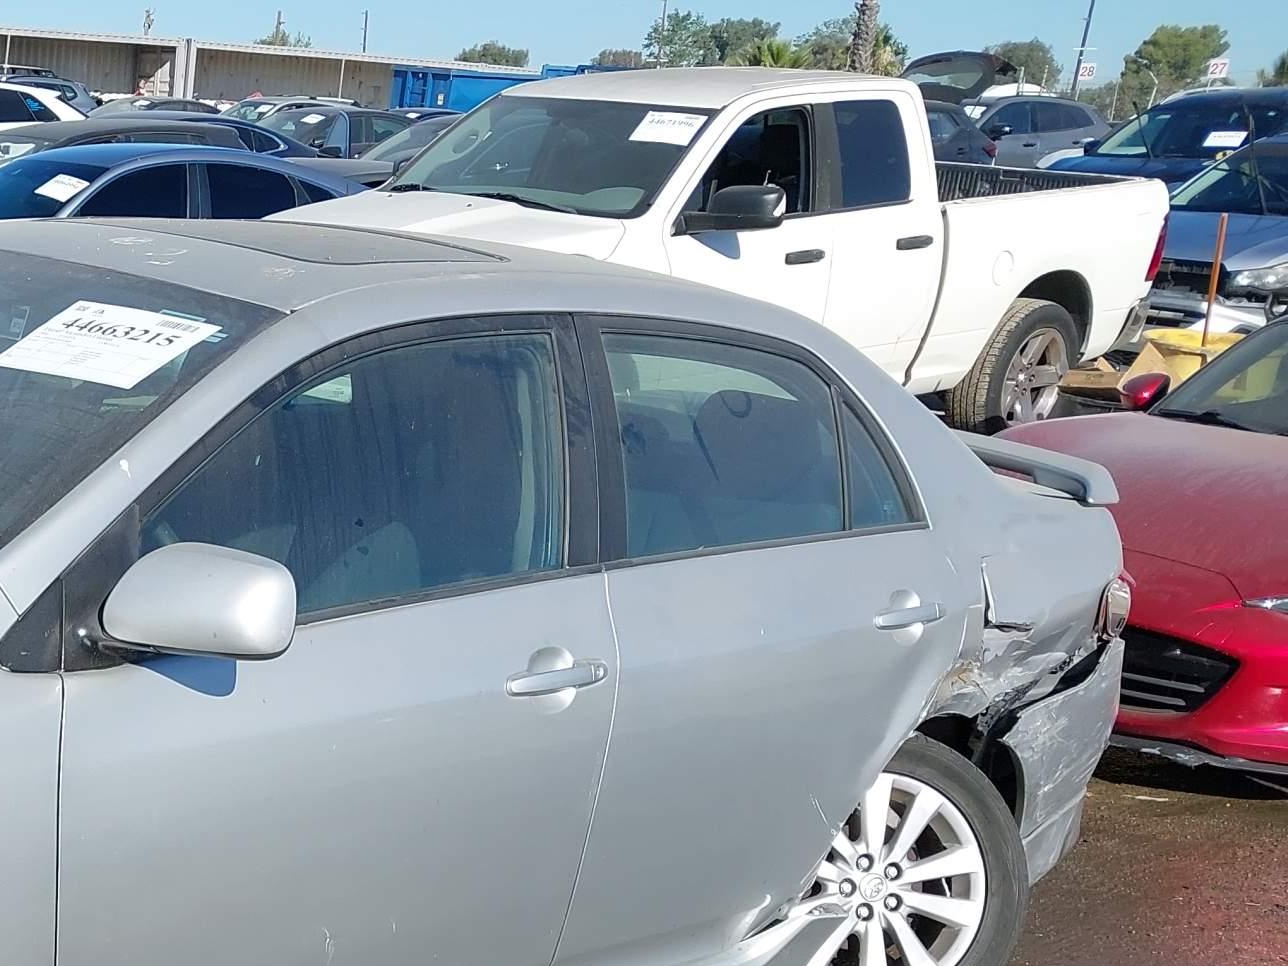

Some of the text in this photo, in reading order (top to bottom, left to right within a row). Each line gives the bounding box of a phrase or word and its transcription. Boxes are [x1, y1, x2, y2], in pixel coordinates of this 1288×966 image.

[1080, 66, 1095, 77] 28
[1210, 63, 1228, 75] 27
[62, 317, 182, 347] 44663215
